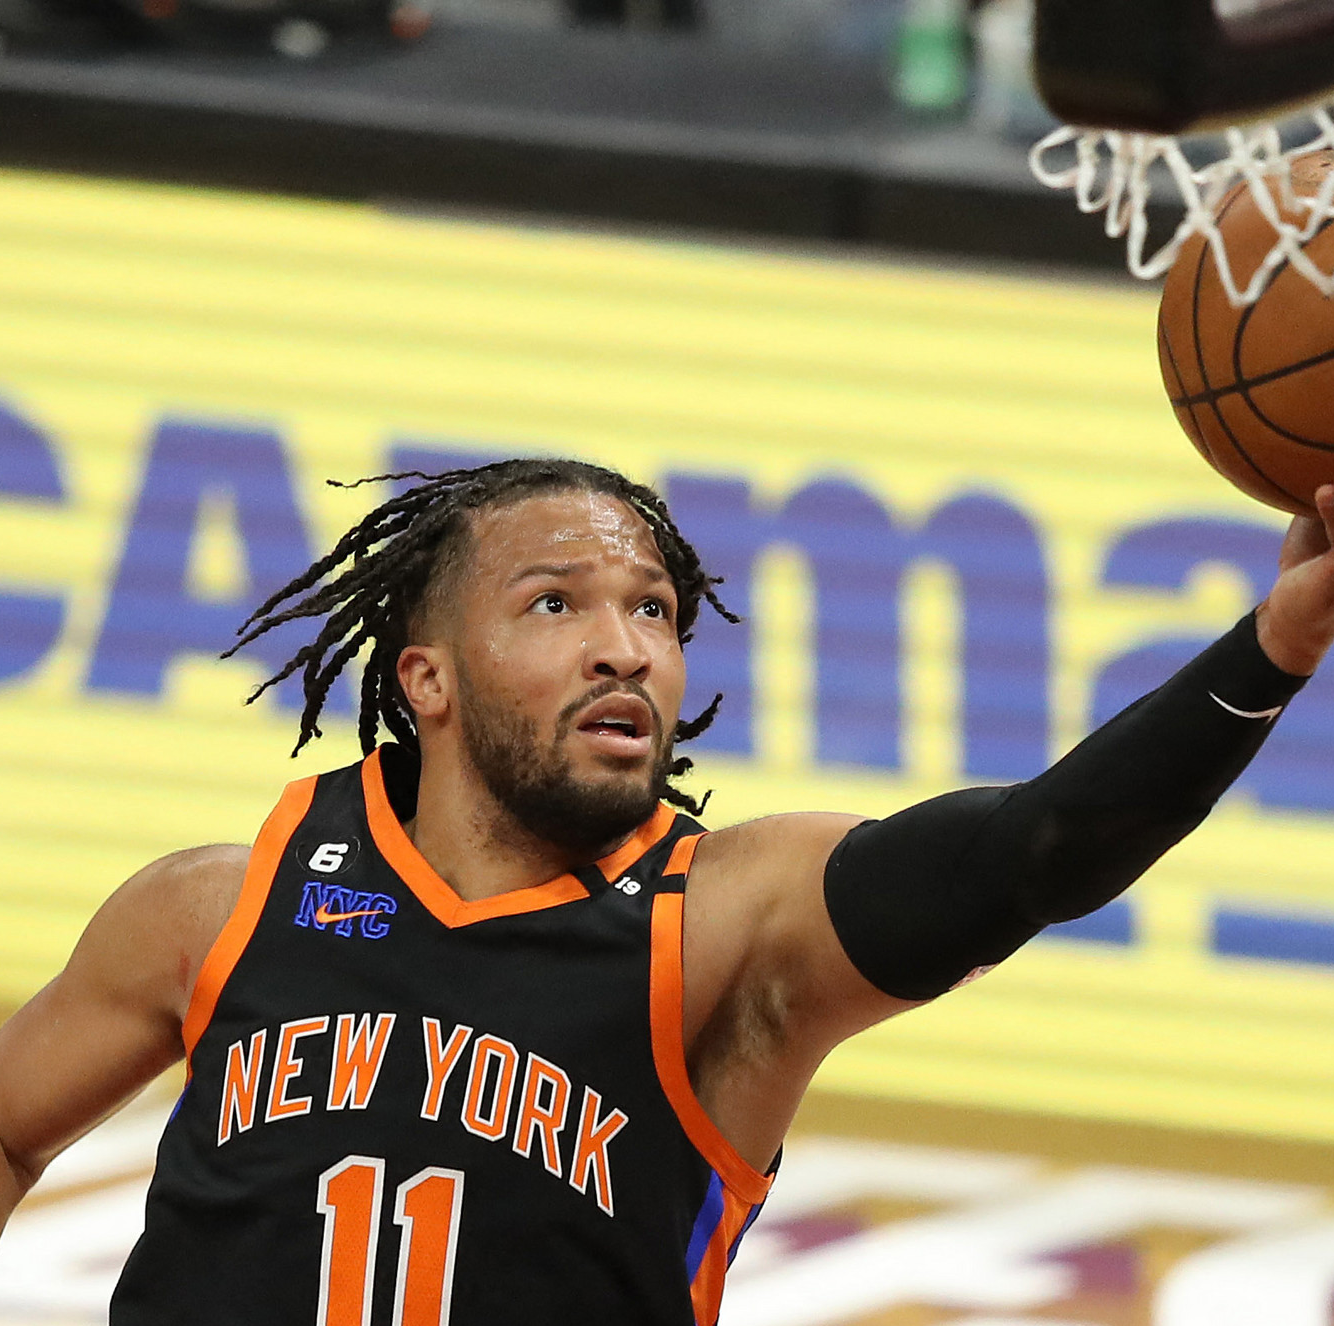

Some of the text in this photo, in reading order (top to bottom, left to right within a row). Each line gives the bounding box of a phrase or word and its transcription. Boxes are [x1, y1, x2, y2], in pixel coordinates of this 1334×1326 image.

[308, 842, 349, 873] 6
[614, 876, 642, 896] 19
[293, 882, 398, 940] NYC
[217, 1012, 629, 1217] NEW YORK
